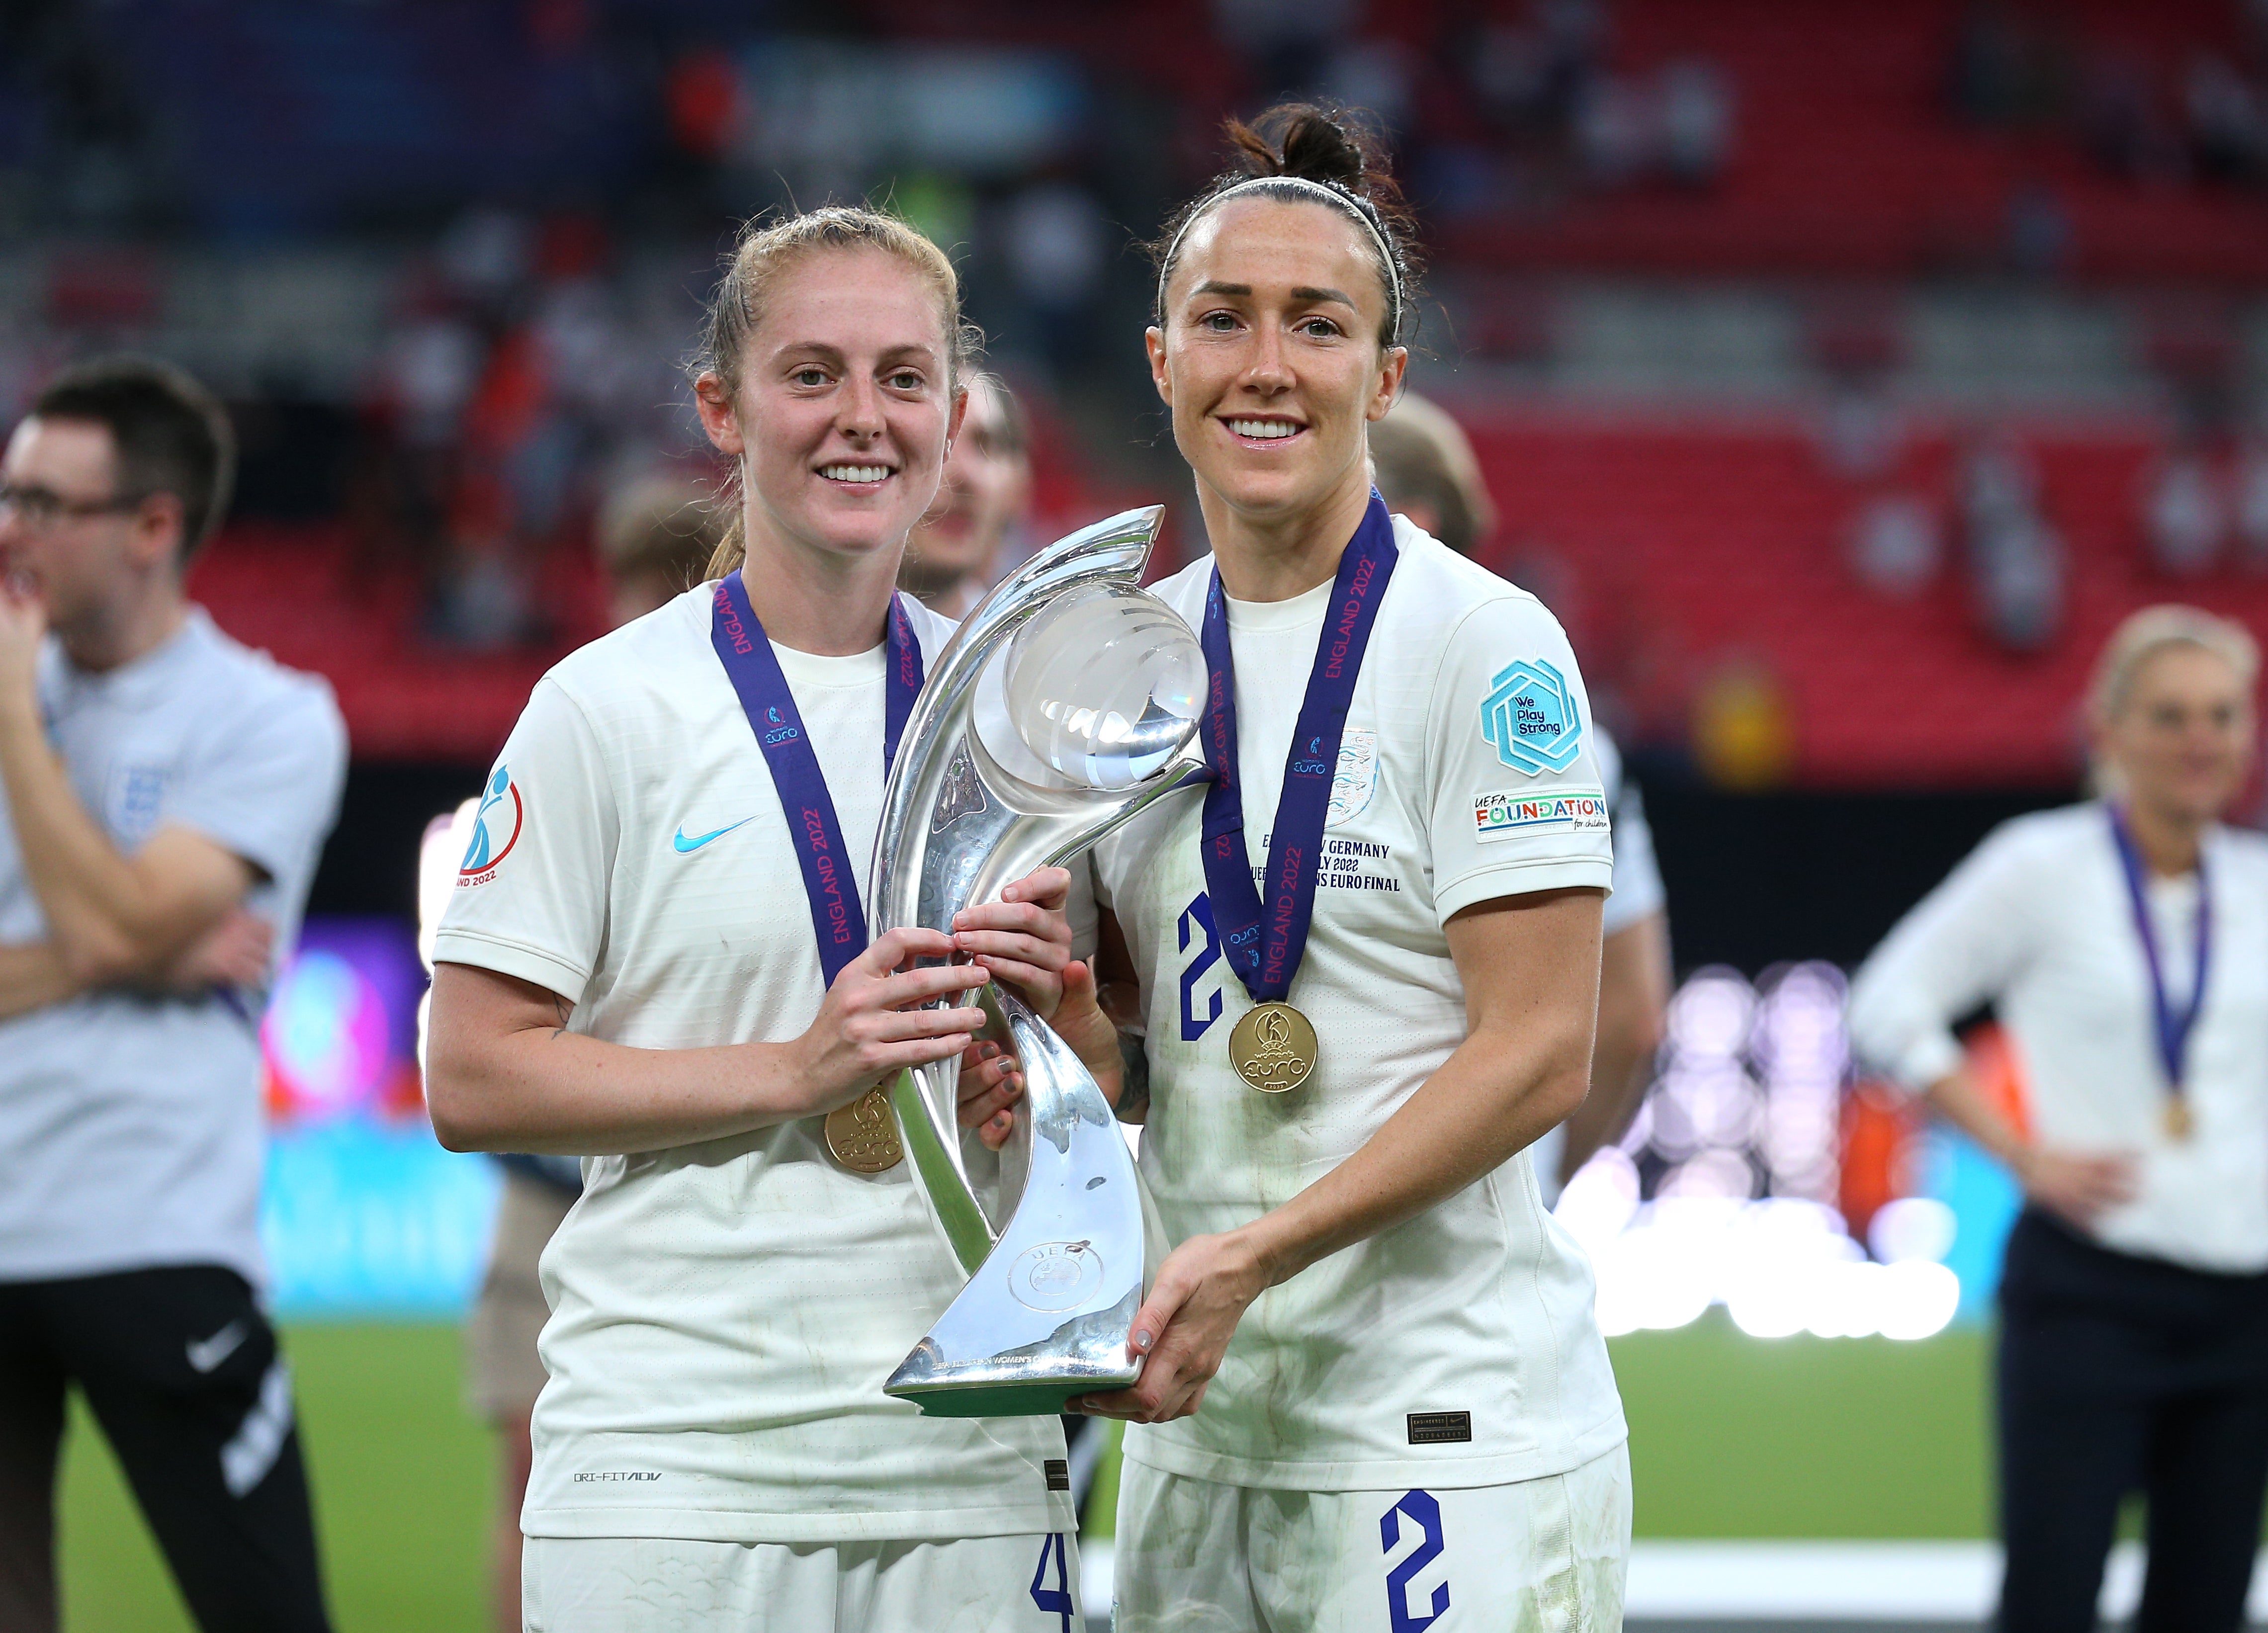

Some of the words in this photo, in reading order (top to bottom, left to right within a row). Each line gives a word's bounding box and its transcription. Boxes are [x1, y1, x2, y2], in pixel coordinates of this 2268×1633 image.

[713, 588, 754, 655] ENGLAND
[1325, 600, 1360, 679] ENGLAND
[1350, 558, 1376, 598] 2022
[1211, 670, 1226, 749] ENGLAND
[1514, 696, 1535, 707] We
[1517, 709, 1545, 723] Play
[1519, 723, 1561, 735] Strong
[1475, 794, 1507, 808] UEFA
[1476, 799, 1605, 826] FOUNDATION
[803, 808, 828, 852] 2022
[1573, 819, 1582, 831] for
[1585, 818, 1608, 828] children
[1329, 840, 1391, 859] GERMANY
[1333, 858, 1359, 872] 2022
[473, 870, 497, 886] 2022
[1330, 874, 1362, 889] EURO
[1364, 876, 1400, 891] FINAL
[818, 855, 851, 944] ENGLAND
[1264, 895, 1294, 984] ENGLAND
[1281, 847, 1302, 891] 2022
[1177, 890, 1223, 1041] 2
[993, 1355, 1032, 1364] WOMEN'S
[1380, 1488, 1451, 1633] 2
[1030, 1533, 1074, 1633] 4
